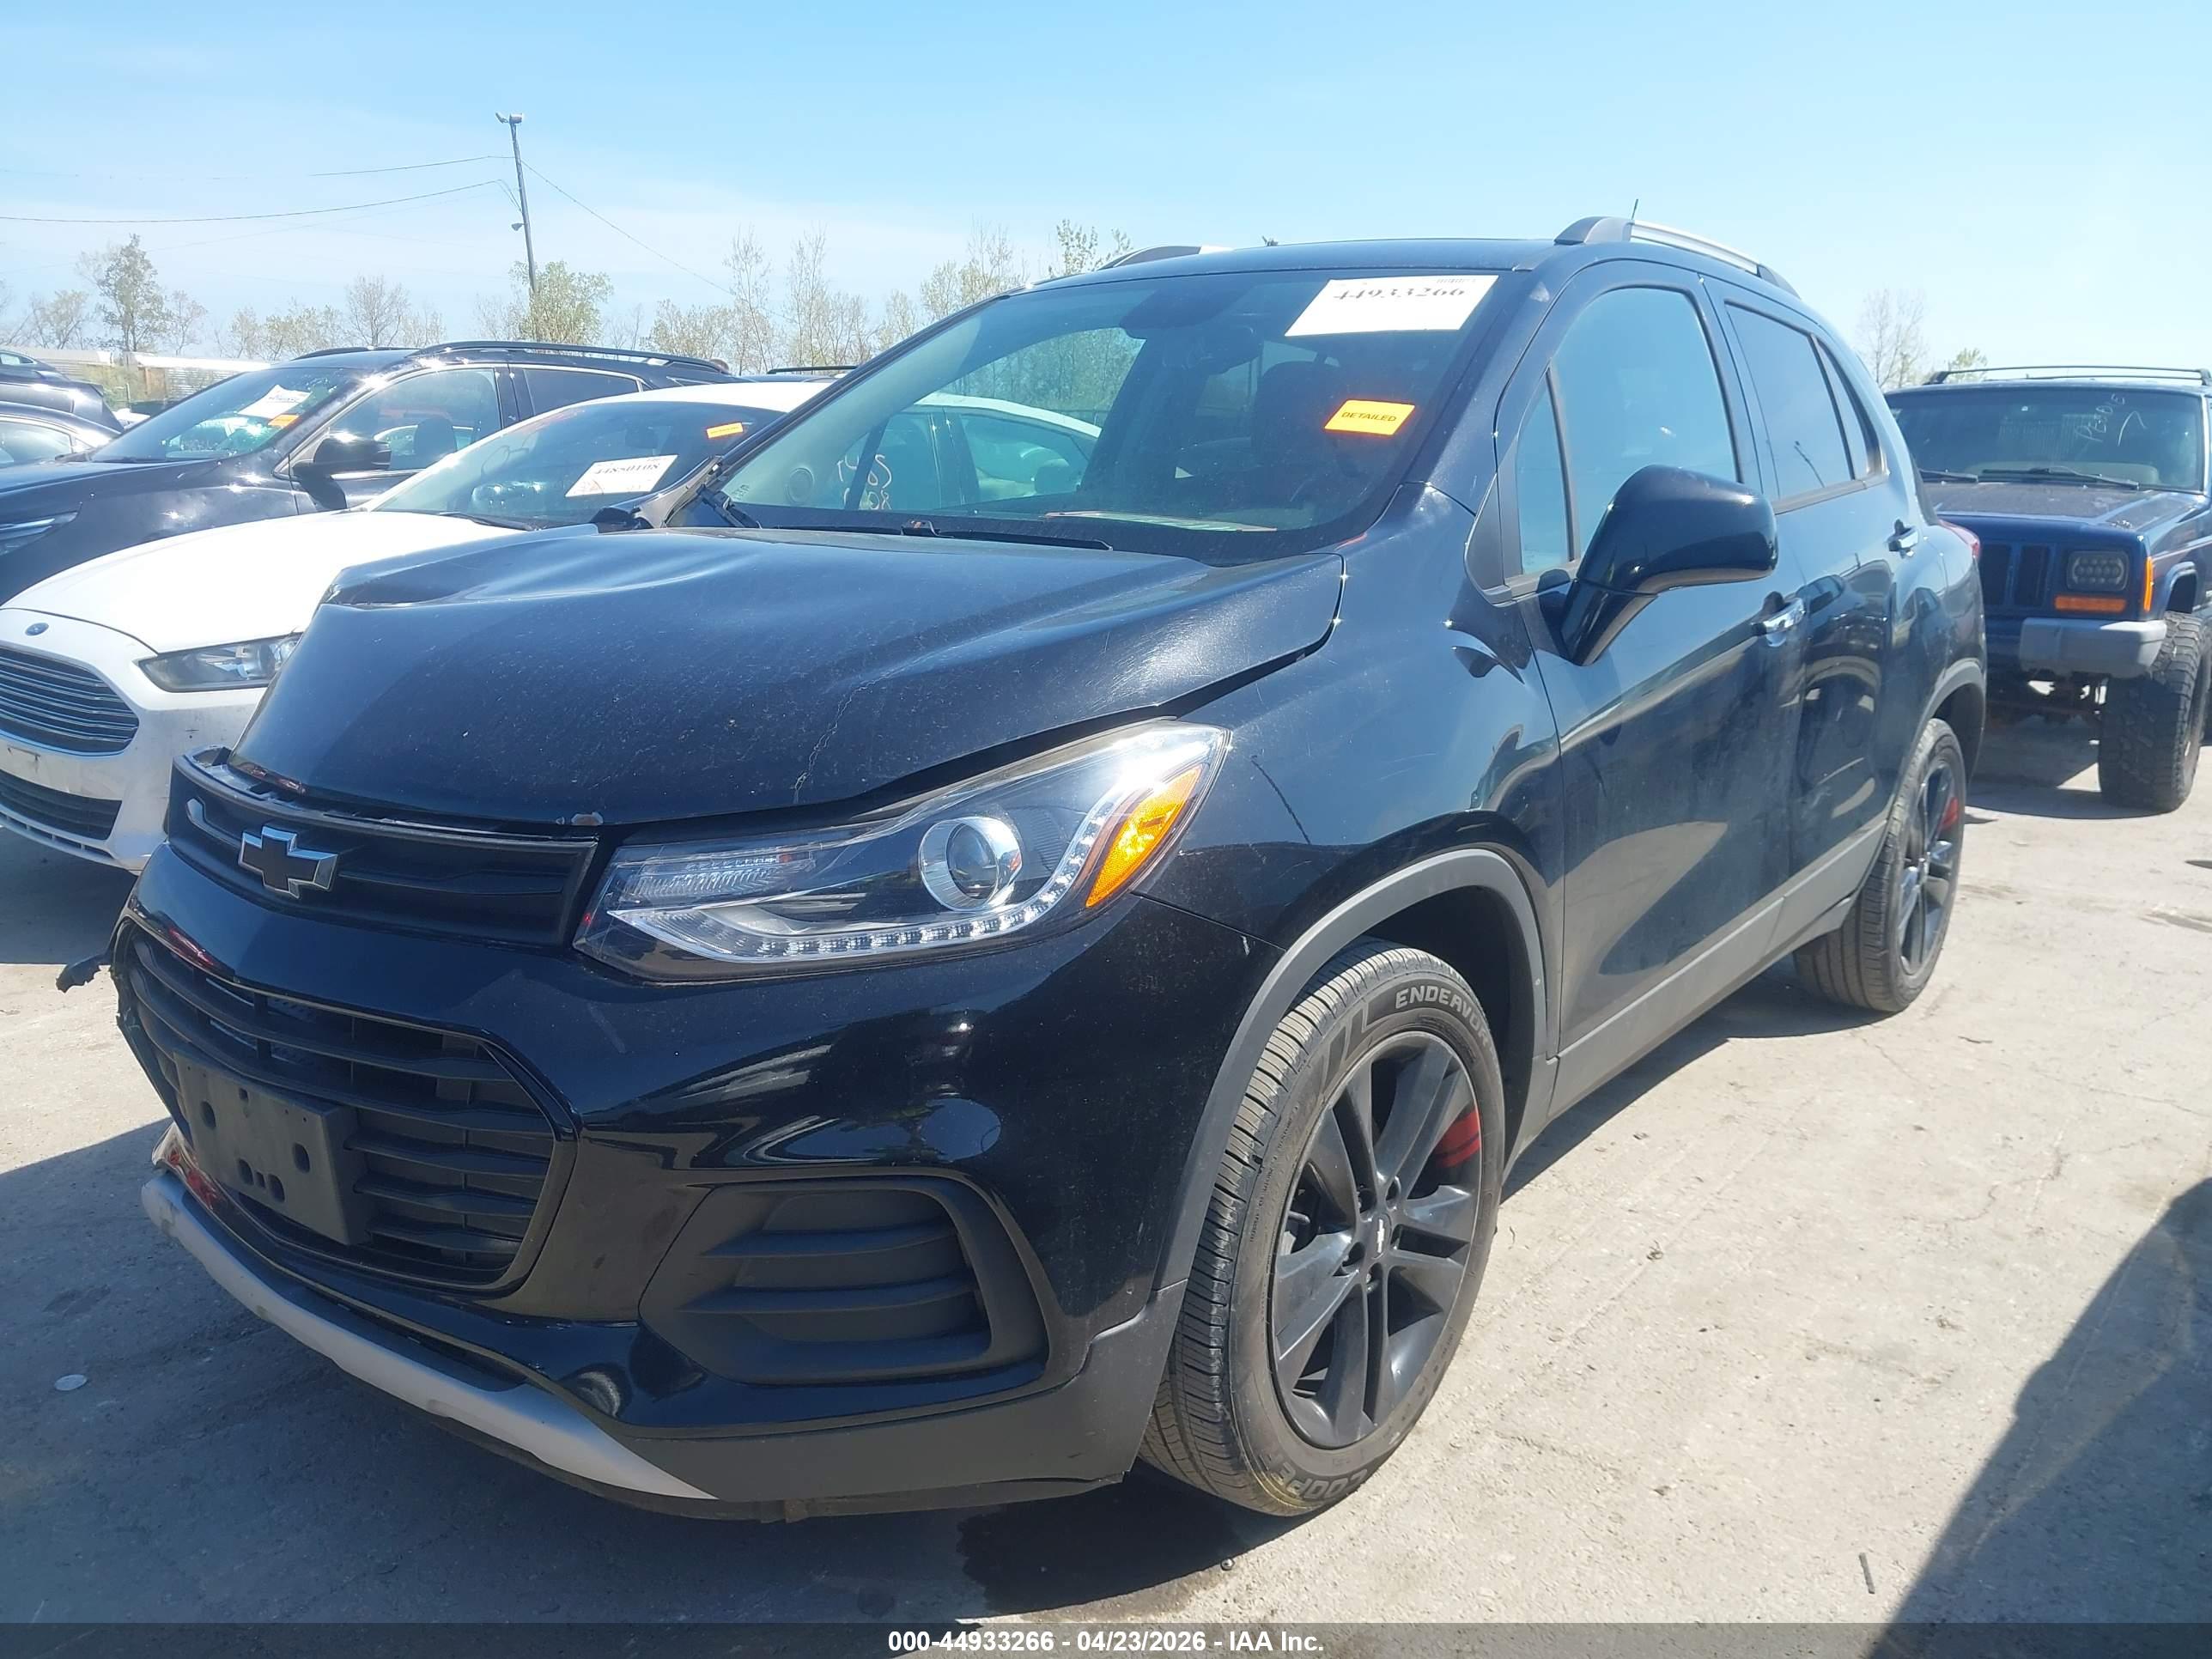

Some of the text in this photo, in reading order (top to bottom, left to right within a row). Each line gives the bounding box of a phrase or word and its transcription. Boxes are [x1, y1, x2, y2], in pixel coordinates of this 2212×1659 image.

[1333, 288, 1465, 300] 44933266
[1341, 411, 1397, 422] DETAILED
[1395, 985, 1489, 1047] ENDEAVOR
